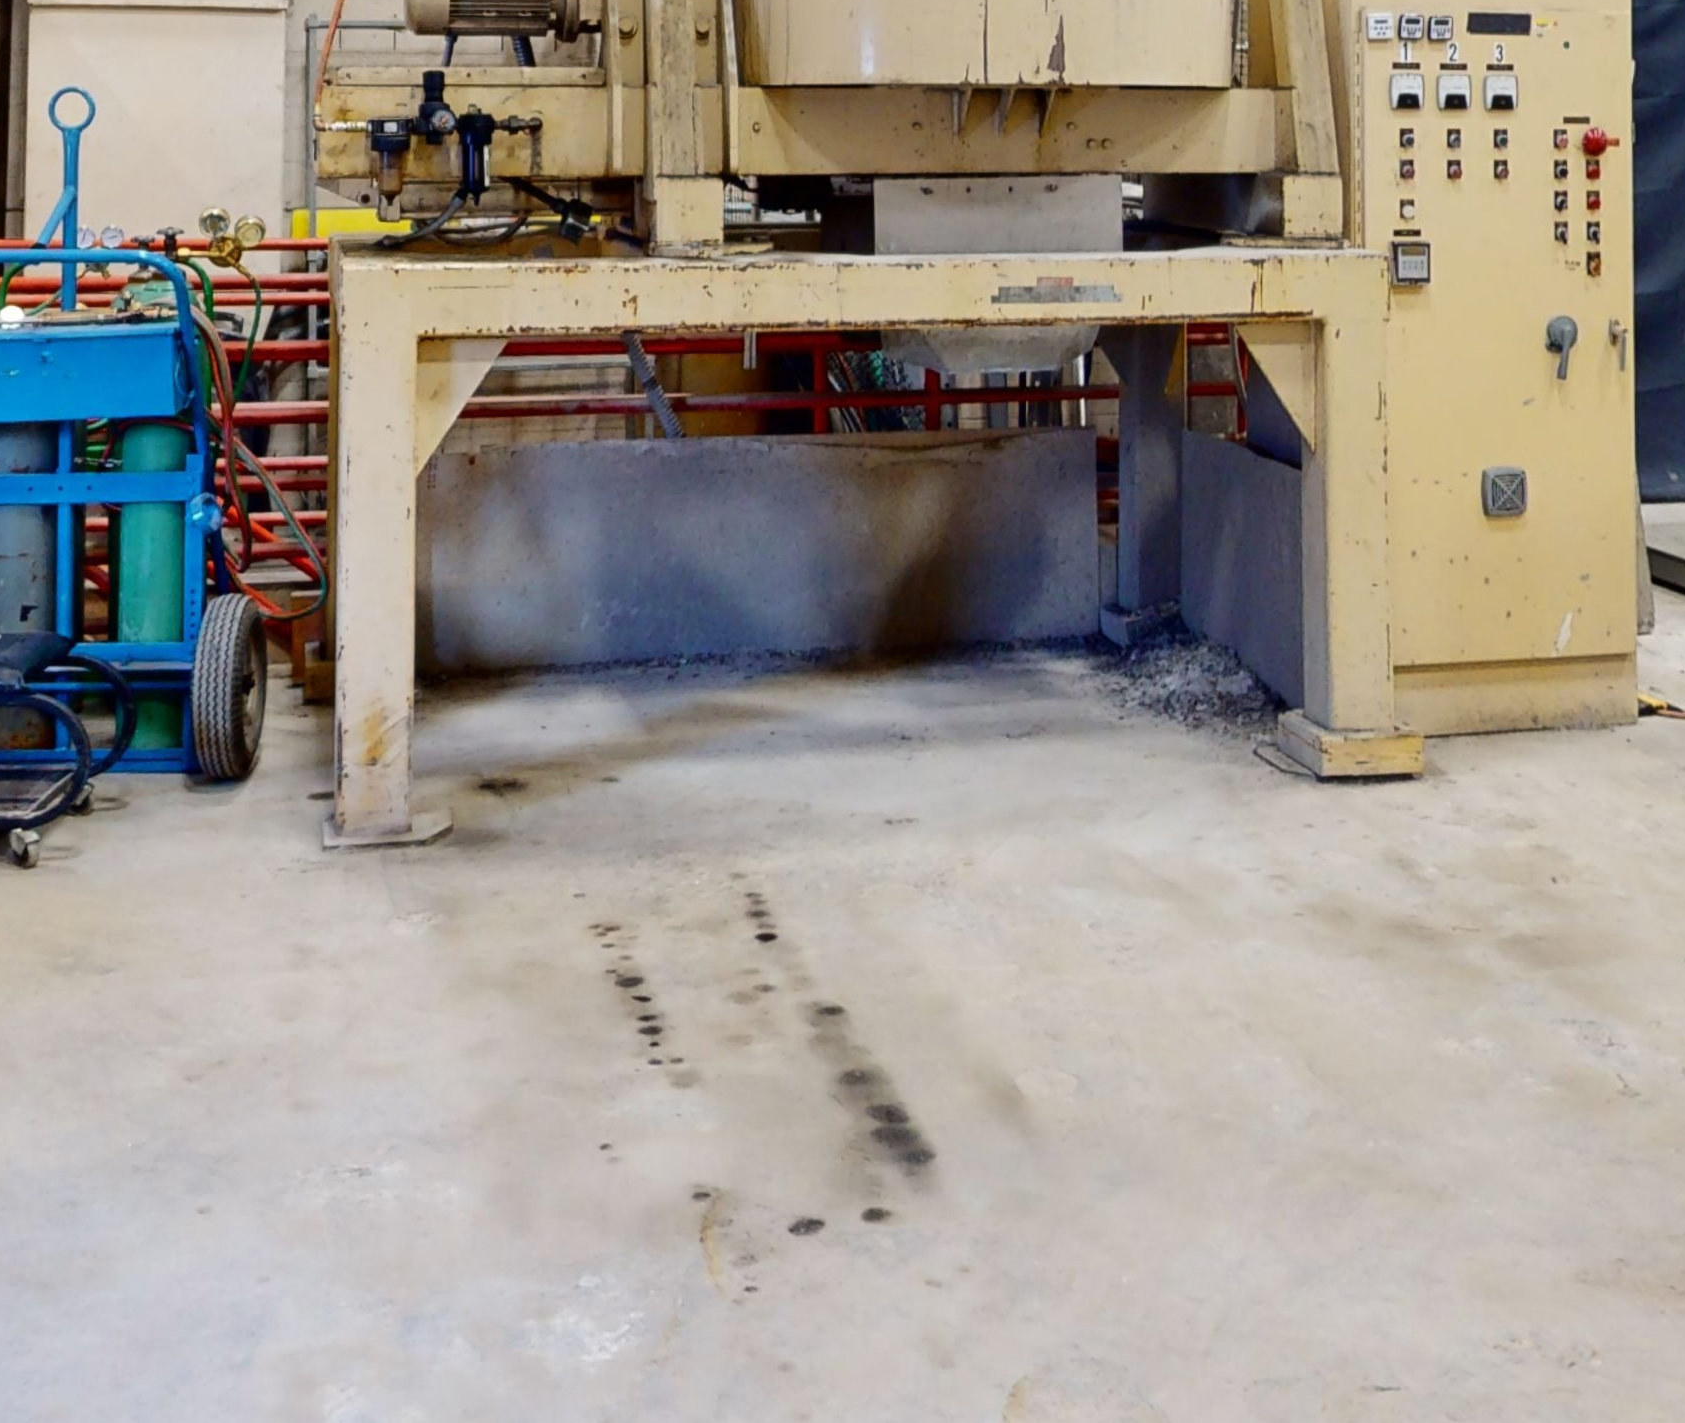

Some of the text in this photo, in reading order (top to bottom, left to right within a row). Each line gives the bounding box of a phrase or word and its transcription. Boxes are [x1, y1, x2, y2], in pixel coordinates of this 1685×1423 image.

[1403, 42, 1409, 60] 1
[1449, 44, 1457, 62] 2
[1495, 44, 1504, 63] 3
